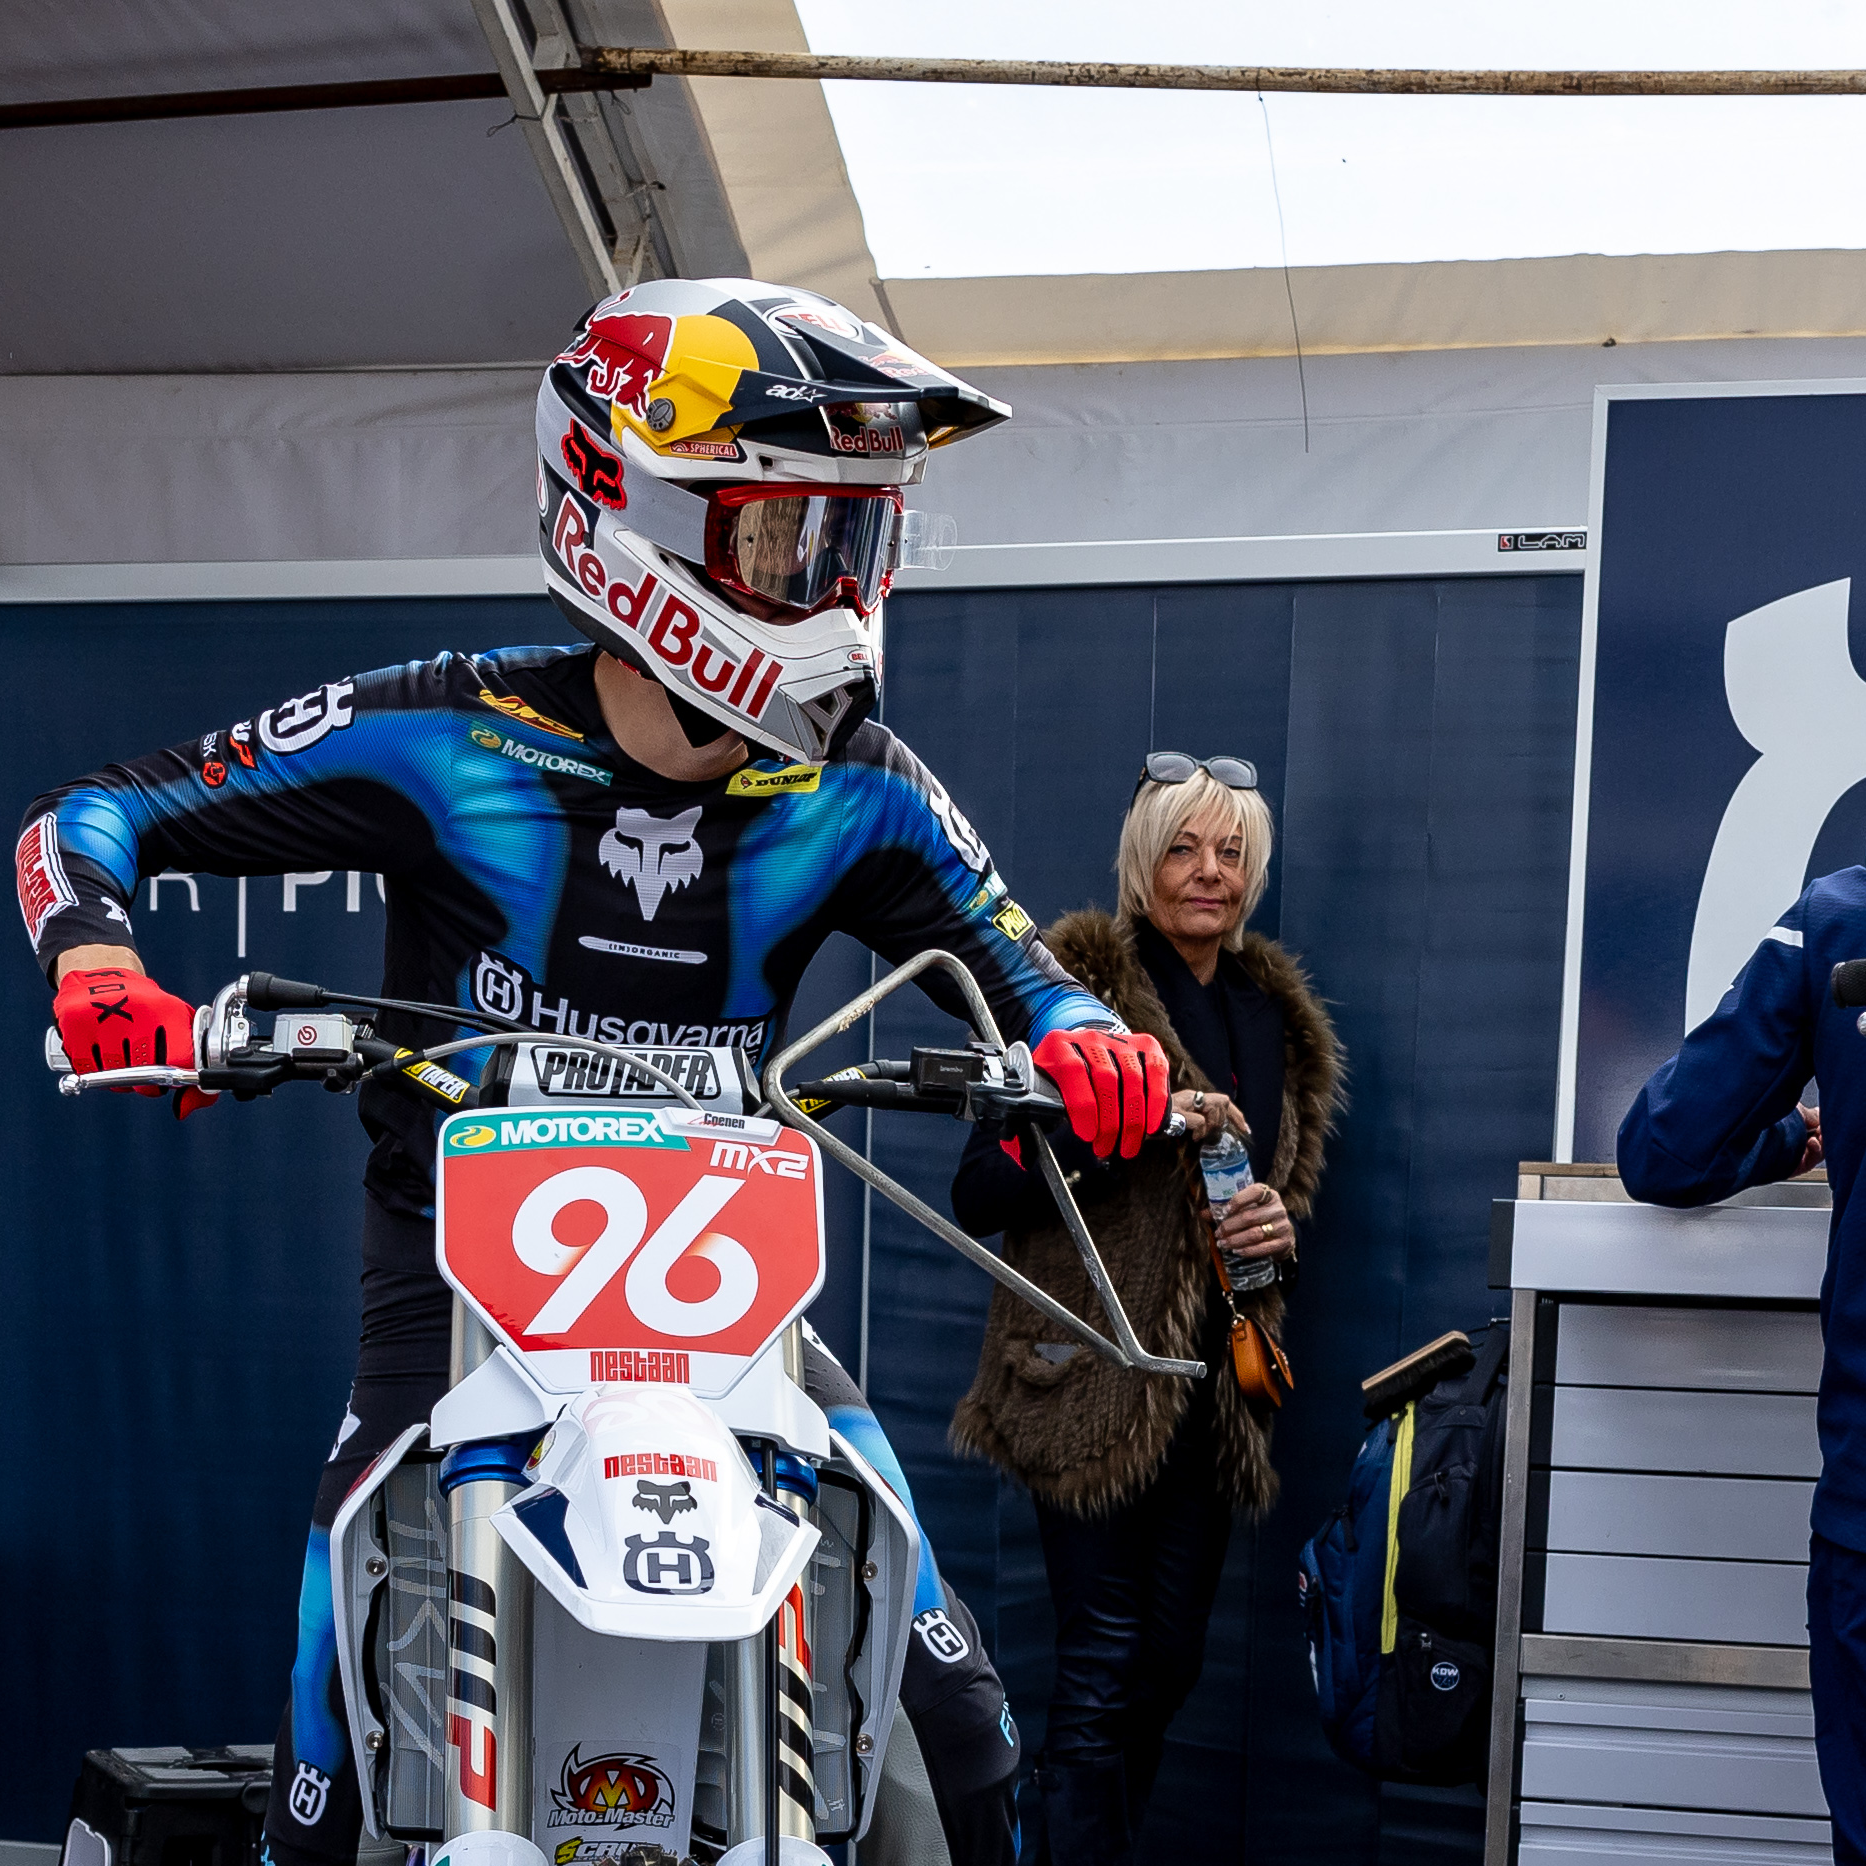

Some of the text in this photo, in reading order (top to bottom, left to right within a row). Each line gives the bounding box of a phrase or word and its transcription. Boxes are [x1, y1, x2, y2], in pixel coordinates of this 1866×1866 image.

[689, 442, 736, 457] SPHERICAL
[830, 425, 904, 453] Red Bull
[1517, 533, 1586, 548] LAM
[553, 492, 784, 719] Red Bull
[501, 738, 608, 783] MOTOREX
[755, 771, 818, 788] DUNLOP
[538, 1050, 710, 1095] PROTAPER
[500, 1117, 665, 1147] MOTOREX
[703, 1111, 746, 1130] Coenen
[709, 1140, 809, 1180] MX2
[511, 1165, 760, 1338] 96
[589, 1350, 691, 1384] nestaan
[604, 1452, 718, 1483] nestaan
